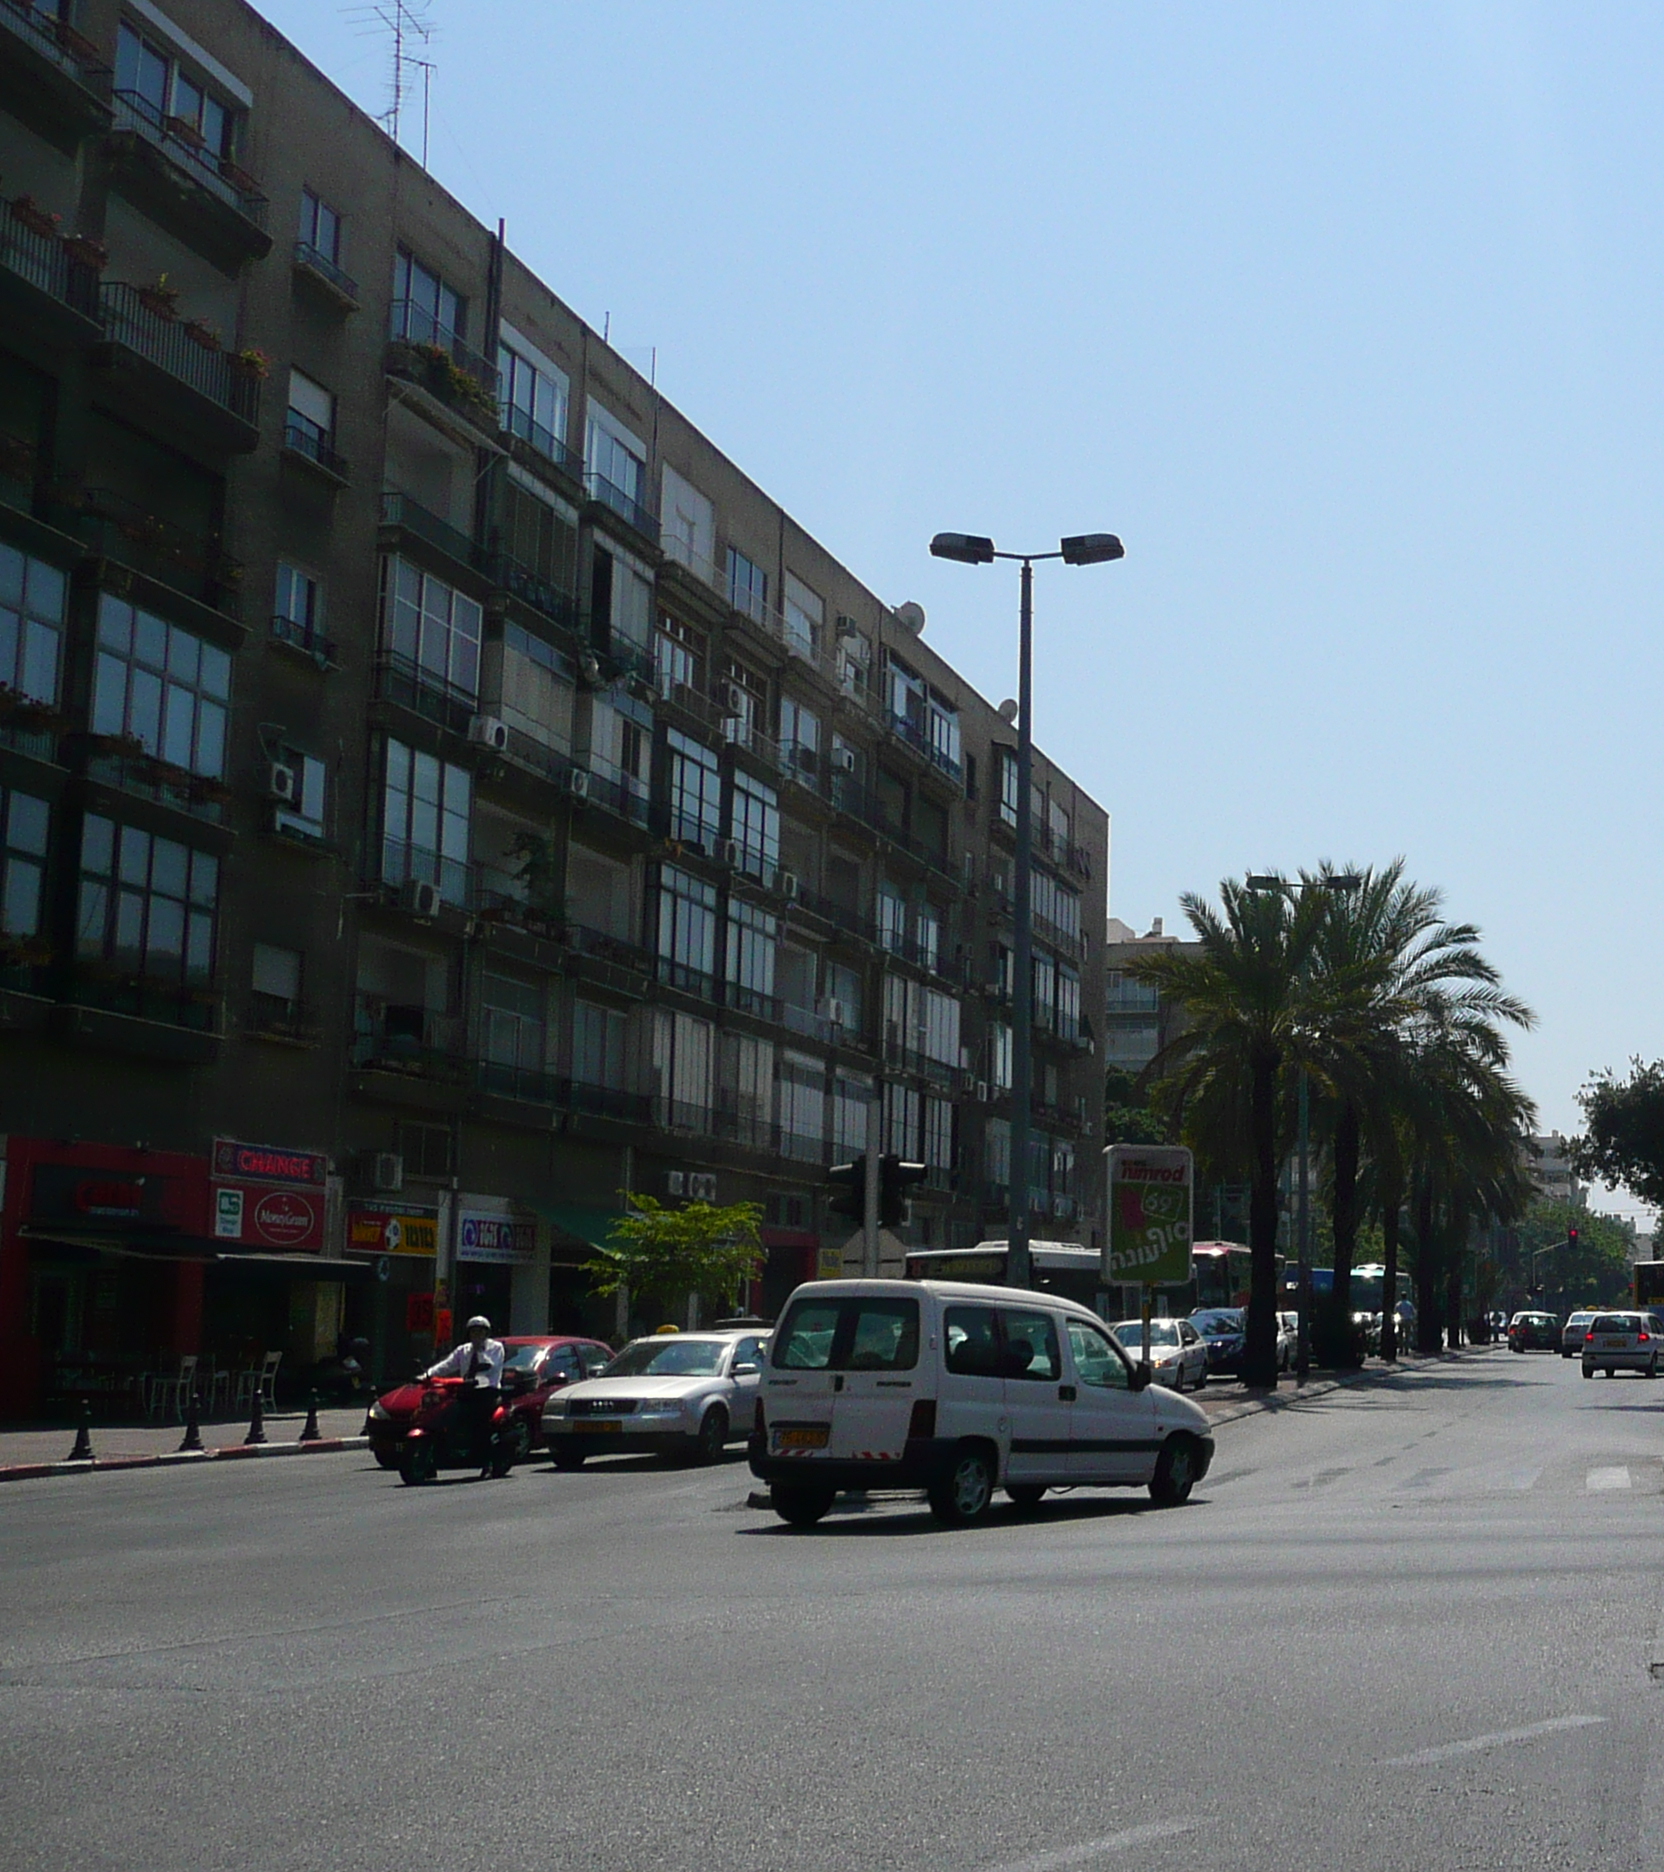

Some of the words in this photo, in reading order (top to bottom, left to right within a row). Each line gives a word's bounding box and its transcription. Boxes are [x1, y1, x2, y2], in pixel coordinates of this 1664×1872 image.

[239, 1150, 311, 1178] CHANGE
[1122, 1166, 1185, 1182] nimrod
[260, 1209, 309, 1228] MoneyGram
[1146, 1221, 1189, 1253] סוף
[1111, 1243, 1160, 1270] עונה
